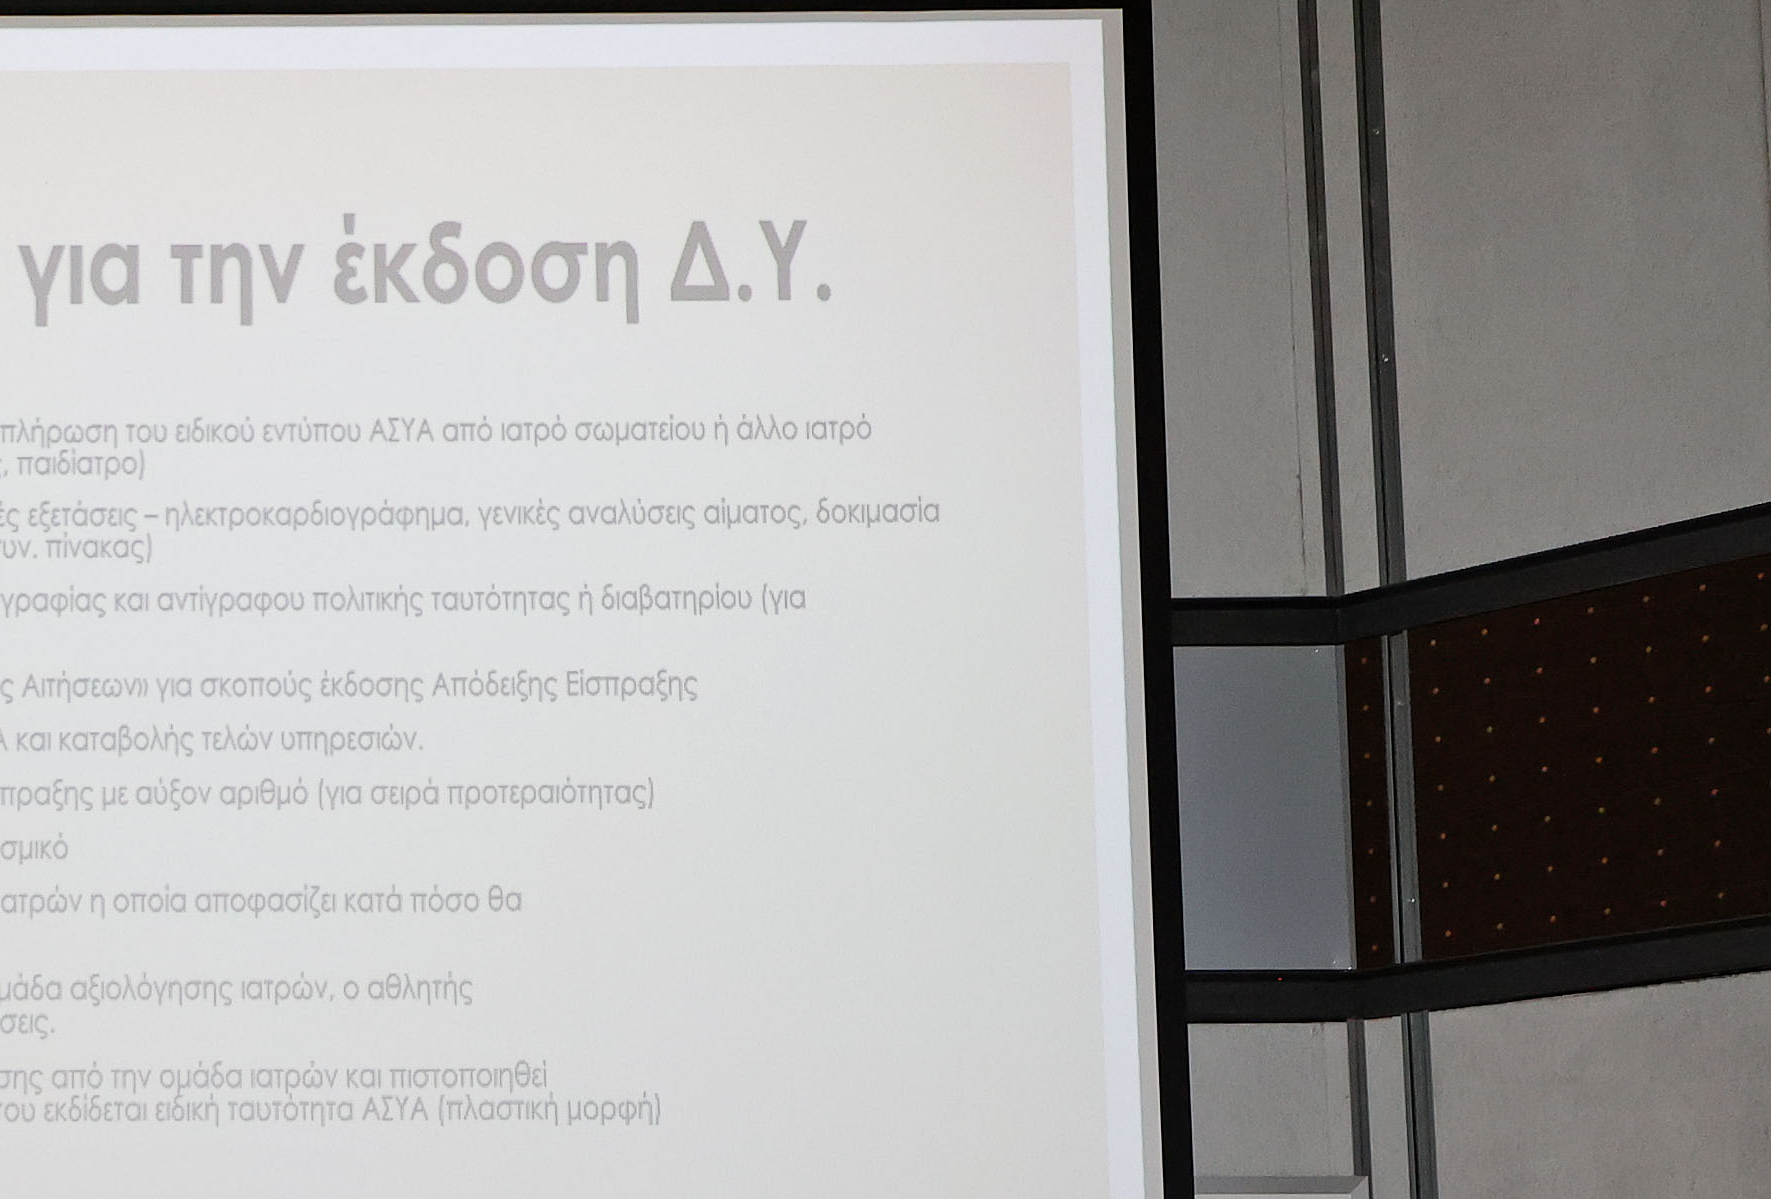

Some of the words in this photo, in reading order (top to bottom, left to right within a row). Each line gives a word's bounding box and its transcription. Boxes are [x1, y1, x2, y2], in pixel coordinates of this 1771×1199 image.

[18, 243, 139, 327] για
[170, 242, 305, 326] την
[333, 213, 639, 325] έκδοση
[670, 219, 831, 302] Δ.Υ.
[126, 423, 167, 443] του
[175, 416, 255, 443] ειδικού
[262, 416, 361, 443] εντύπου
[369, 417, 434, 443] ΑΣΥΑ
[442, 415, 493, 442] από
[501, 414, 567, 447] ιατρό
[575, 414, 705, 446] σωματείου
[714, 413, 729, 448] ή
[736, 414, 798, 441] άλλο
[806, 413, 872, 446] ιατρό
[17, 449, 145, 480] παιδίατρο)
[28, 500, 138, 534] εξετάσεις
[478, 498, 560, 531] γενικές
[568, 498, 695, 530] αναλύσεις
[703, 497, 807, 530] αίματος,
[816, 495, 940, 528] δοκιμασία
[45, 532, 152, 564] πίνακας)
[114, 592, 149, 612] και
[157, 585, 305, 617] αντίγραφου
[312, 584, 423, 617] πολιτικής
[431, 583, 570, 617] ταυτότητας
[579, 583, 593, 617] ή
[601, 582, 752, 616] διαβατηρίου
[762, 583, 806, 615] (για
[156, 677, 192, 703] για
[200, 670, 312, 703] σκοπούς
[320, 670, 424, 703] έκδοσης
[432, 669, 558, 702] Απόδειξης
[566, 668, 698, 702] Είσπραξης
[16, 732, 51, 752] και
[59, 724, 194, 757] καταβολής
[201, 724, 273, 751] τελών
[281, 723, 423, 756] υπηρεσιών.
[102, 786, 128, 811] με
[135, 778, 212, 811] αύξον
[219, 777, 309, 810] αριθμό
[318, 778, 362, 810] (για
[371, 777, 439, 810] σειρά
[447, 776, 654, 810] προτεραιότητας)
[91, 893, 105, 919] η
[113, 884, 186, 913] οποία
[195, 884, 336, 919] αποφασίζει
[344, 884, 402, 913] κατά
[410, 884, 480, 913] πόσο
[488, 885, 522, 912] θα
[70, 972, 233, 1007] αξιολόγησης
[343, 980, 359, 1000] ο
[368, 971, 472, 1006] αθλητής
[52, 1061, 103, 1089] από
[111, 1069, 151, 1094] την
[160, 1061, 242, 1095] ομάδα
[251, 1060, 338, 1095] ιατρών
[346, 1068, 381, 1088] και
[388, 1060, 547, 1094] πιστοποιηθεί
[44, 1094, 147, 1122] εκδίδεται
[155, 1094, 219, 1128] ειδική
[228, 1094, 353, 1127] ταυτότητα
[362, 1095, 428, 1121] ΑΣΥΑ
[438, 1093, 558, 1126] (πλαστική
[567, 1091, 661, 1126] μορφή)
